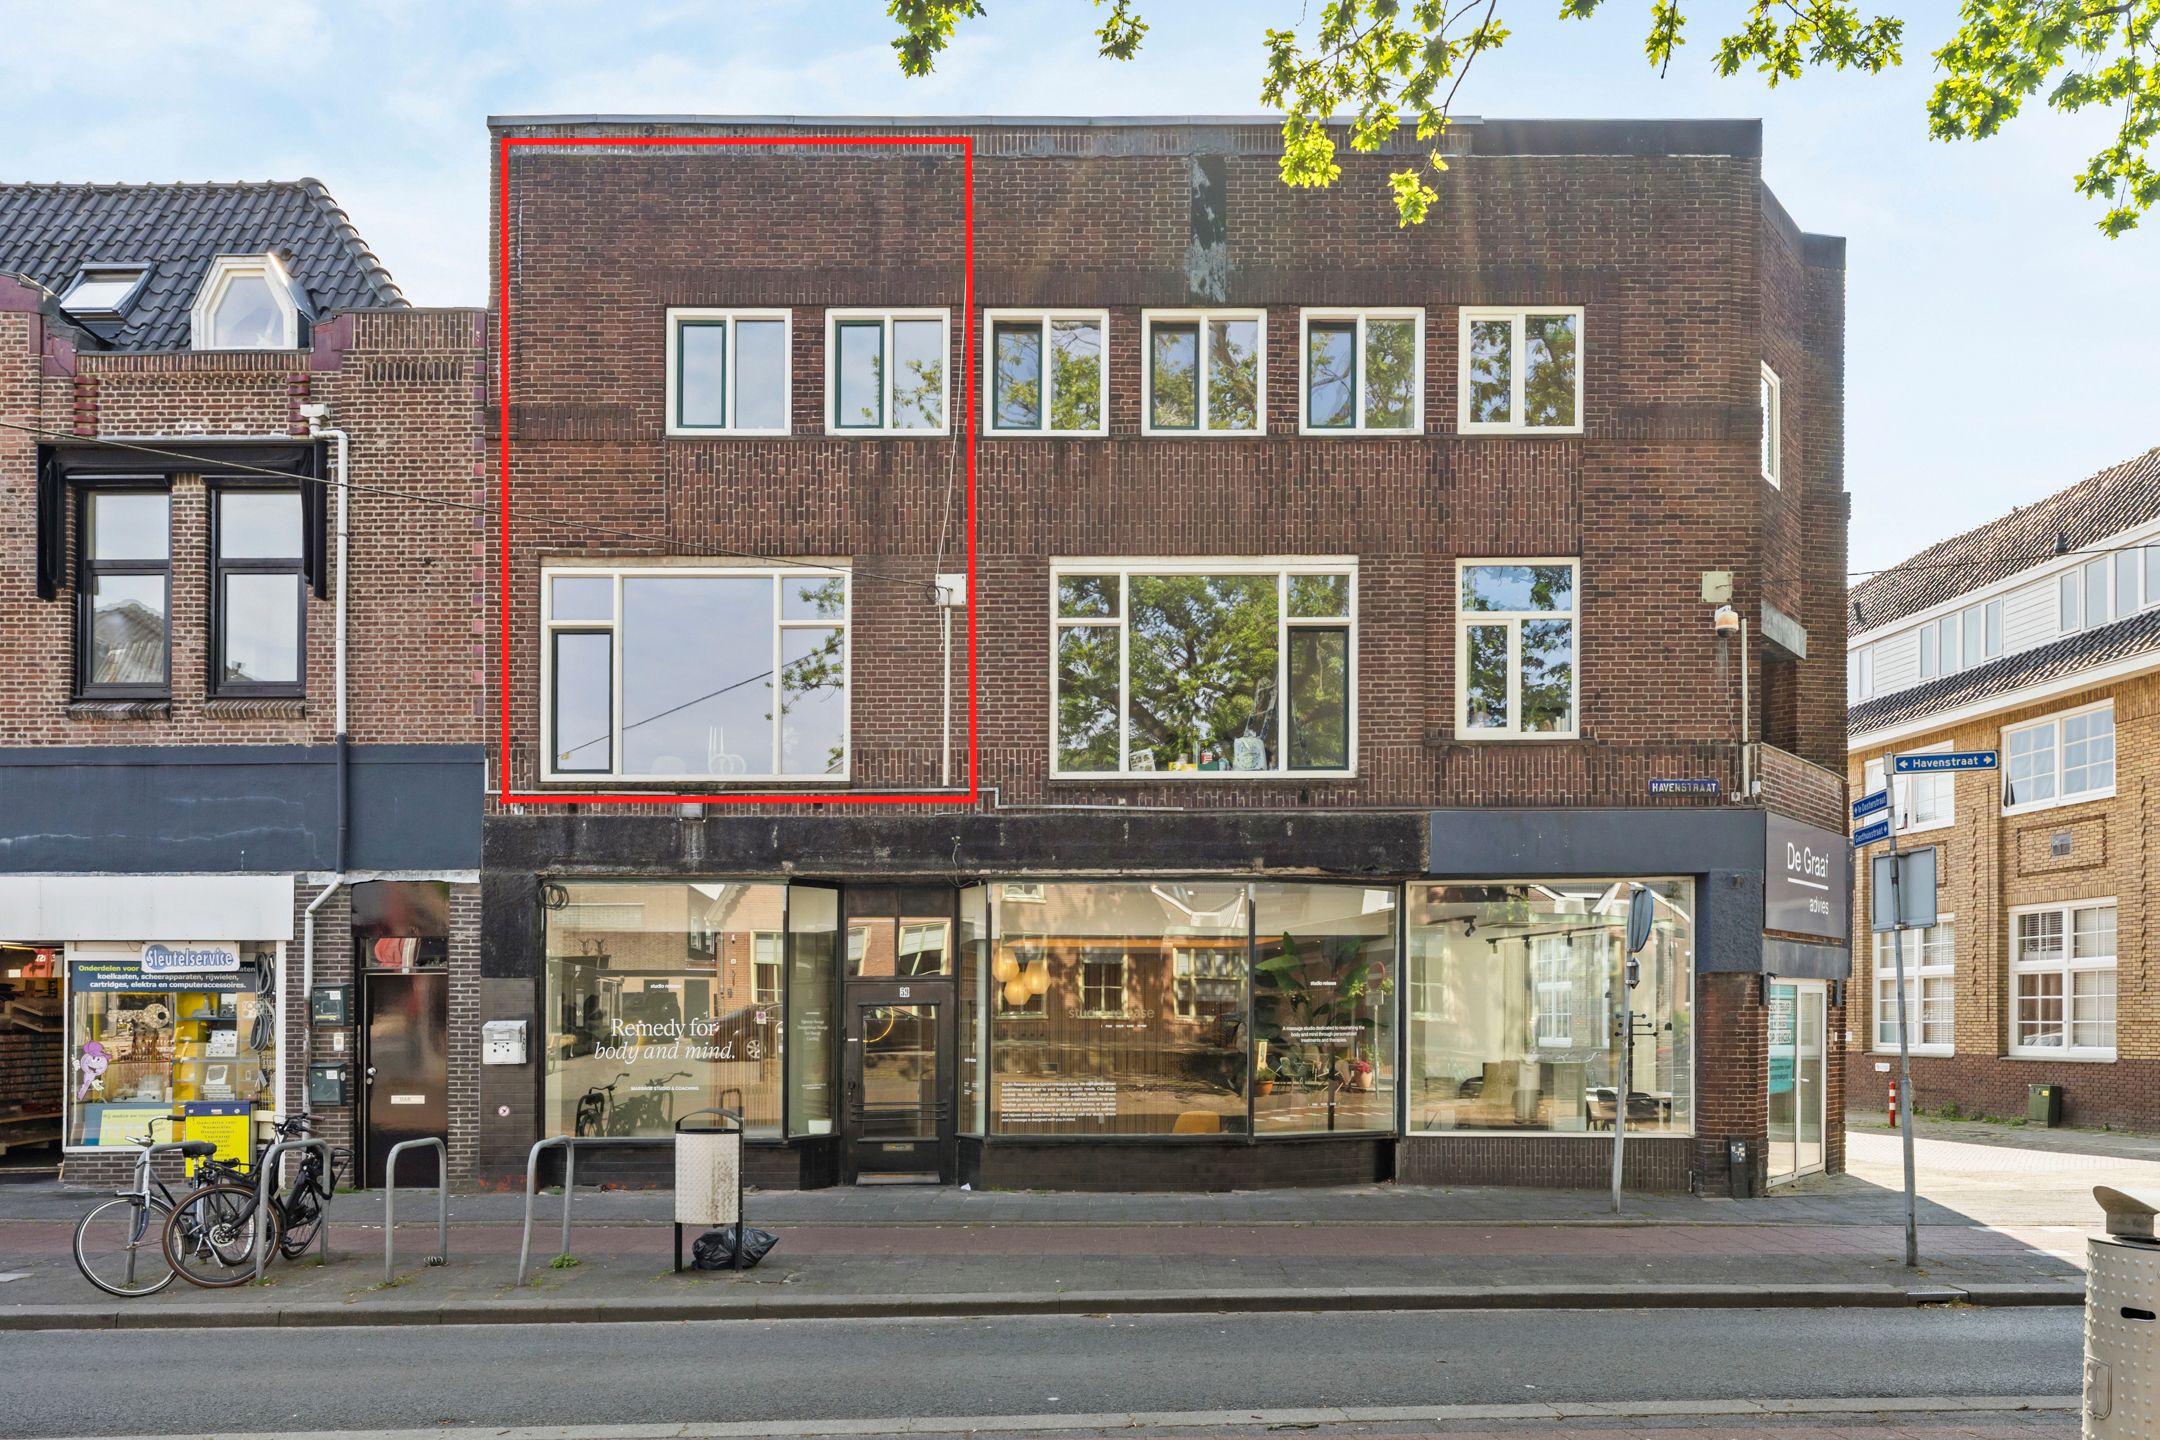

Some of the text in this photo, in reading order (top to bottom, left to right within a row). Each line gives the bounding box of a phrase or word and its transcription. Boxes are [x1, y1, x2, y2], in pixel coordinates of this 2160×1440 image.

[1913, 756, 1979, 768] Havenstraat
[1652, 783, 1717, 793] HAVENSTRAAT
[1787, 842, 1829, 878] De Graaf
[1809, 897, 1829, 915] advies
[146, 948, 234, 967] Sleutelservice
[141, 973, 204, 981] scheerapparaten,
[205, 973, 239, 981] rijwielen,
[90, 981, 129, 989] cartridges,
[169, 981, 247, 989] computeraccessoires.
[900, 986, 910, 997] 59
[611, 1018, 716, 1040] Remedy for
[594, 1042, 735, 1064] body and mind.
